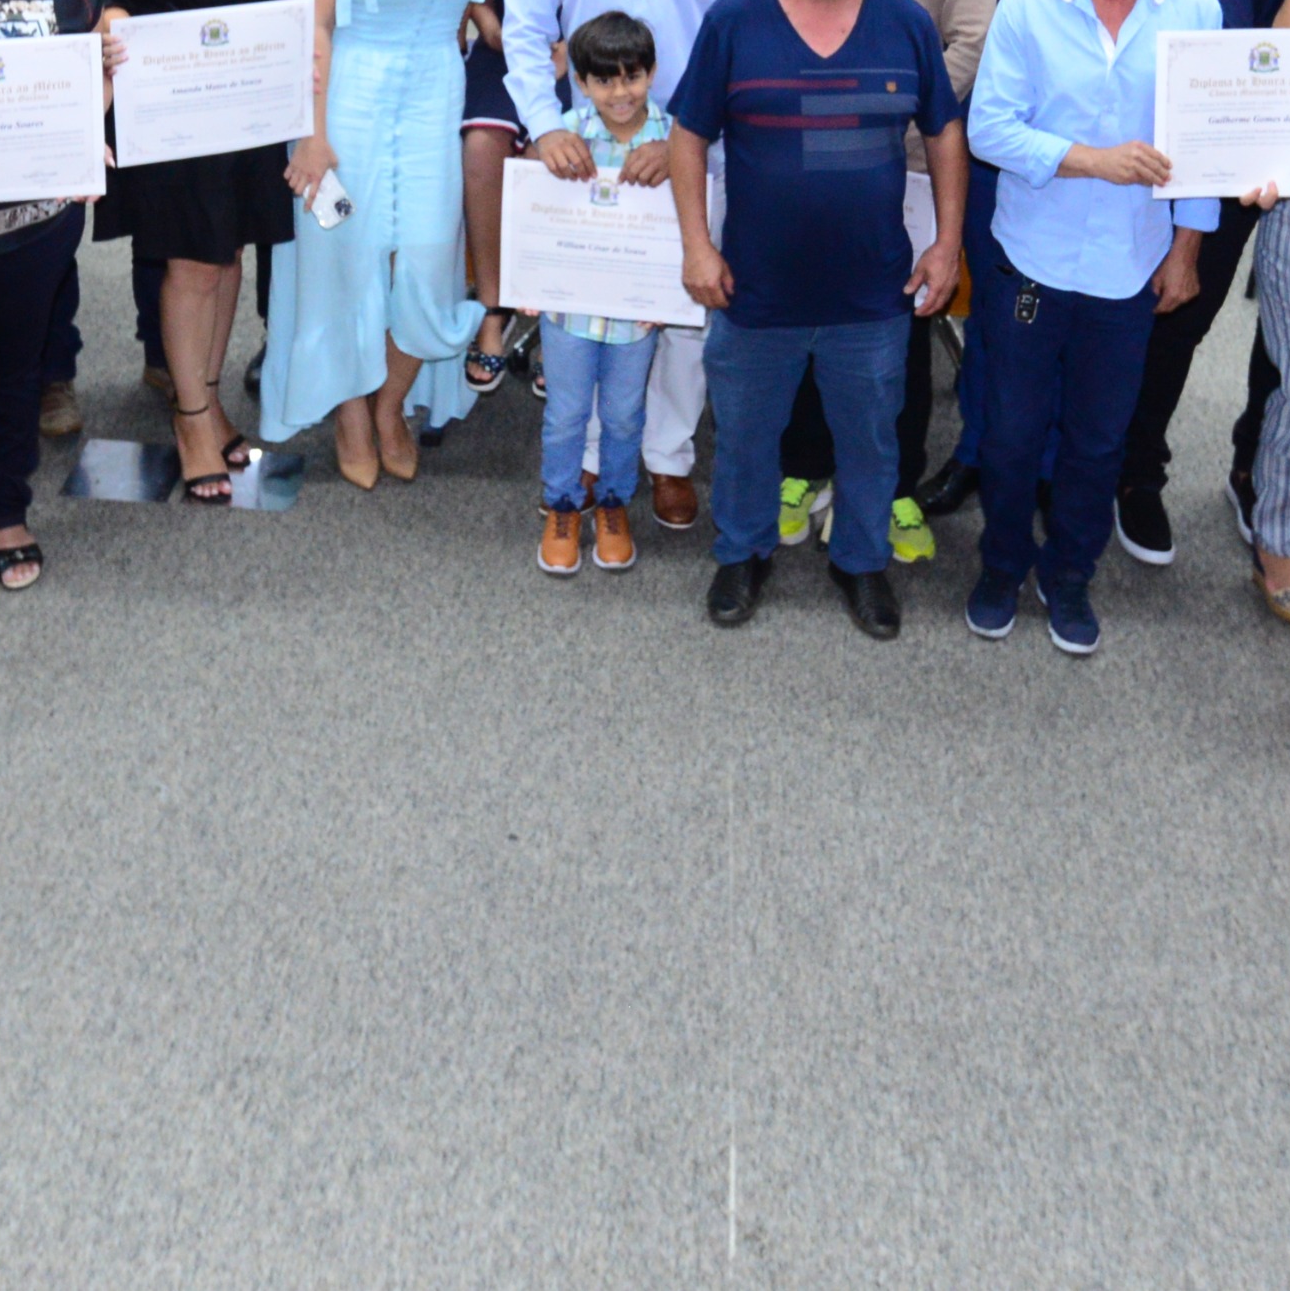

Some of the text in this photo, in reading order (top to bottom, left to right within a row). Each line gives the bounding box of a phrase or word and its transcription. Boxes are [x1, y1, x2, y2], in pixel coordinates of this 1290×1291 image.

[16, 84, 28, 93] ao
[33, 79, 70, 92] Mérito
[1189, 78, 1232, 88] Diploma
[1236, 77, 1246, 86] de
[1251, 77, 1284, 86] Honra
[14, 120, 43, 129] Soares
[1208, 116, 1249, 124] Guilherme
